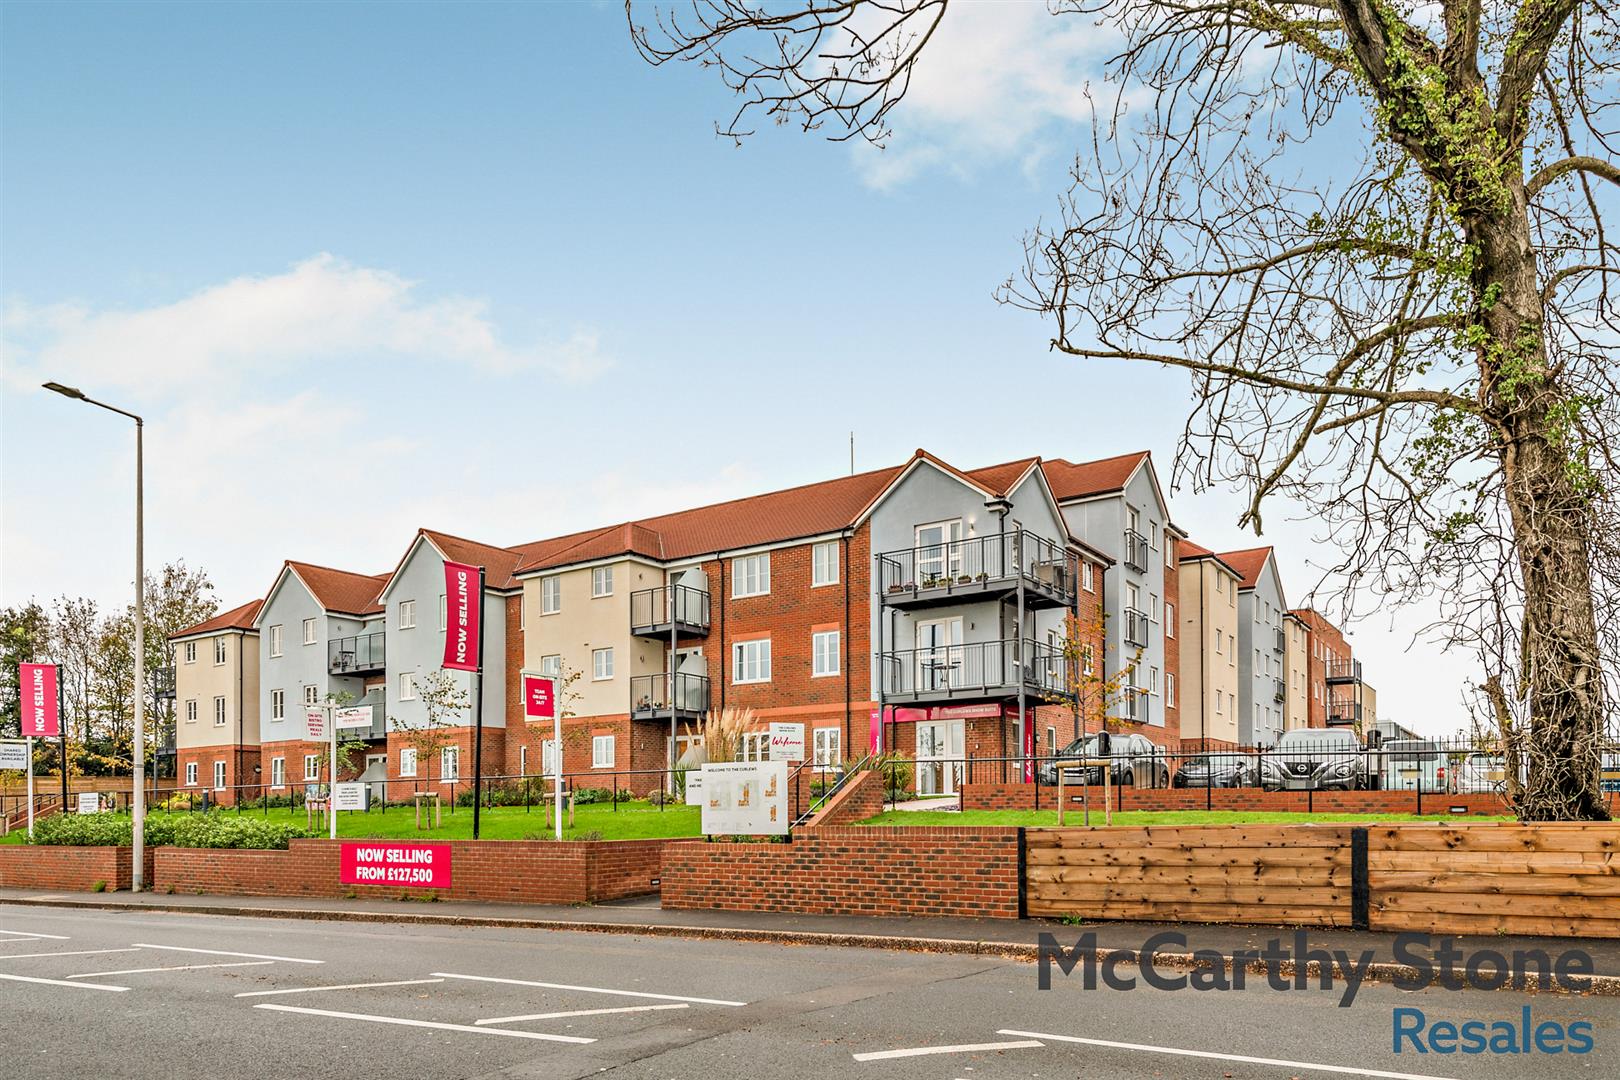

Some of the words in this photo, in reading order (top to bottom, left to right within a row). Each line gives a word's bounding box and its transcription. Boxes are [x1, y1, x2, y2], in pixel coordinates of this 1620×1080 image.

[458, 571, 468, 627] SELLING
[456, 628, 467, 663] NOW
[34, 668, 44, 706] SELLING
[35, 708, 45, 732] NOW
[772, 736, 802, 747] Welcome
[356, 847, 385, 863] NOW
[386, 848, 433, 864] SELLING
[356, 866, 385, 880] FROM
[387, 867, 433, 883] £127,500
